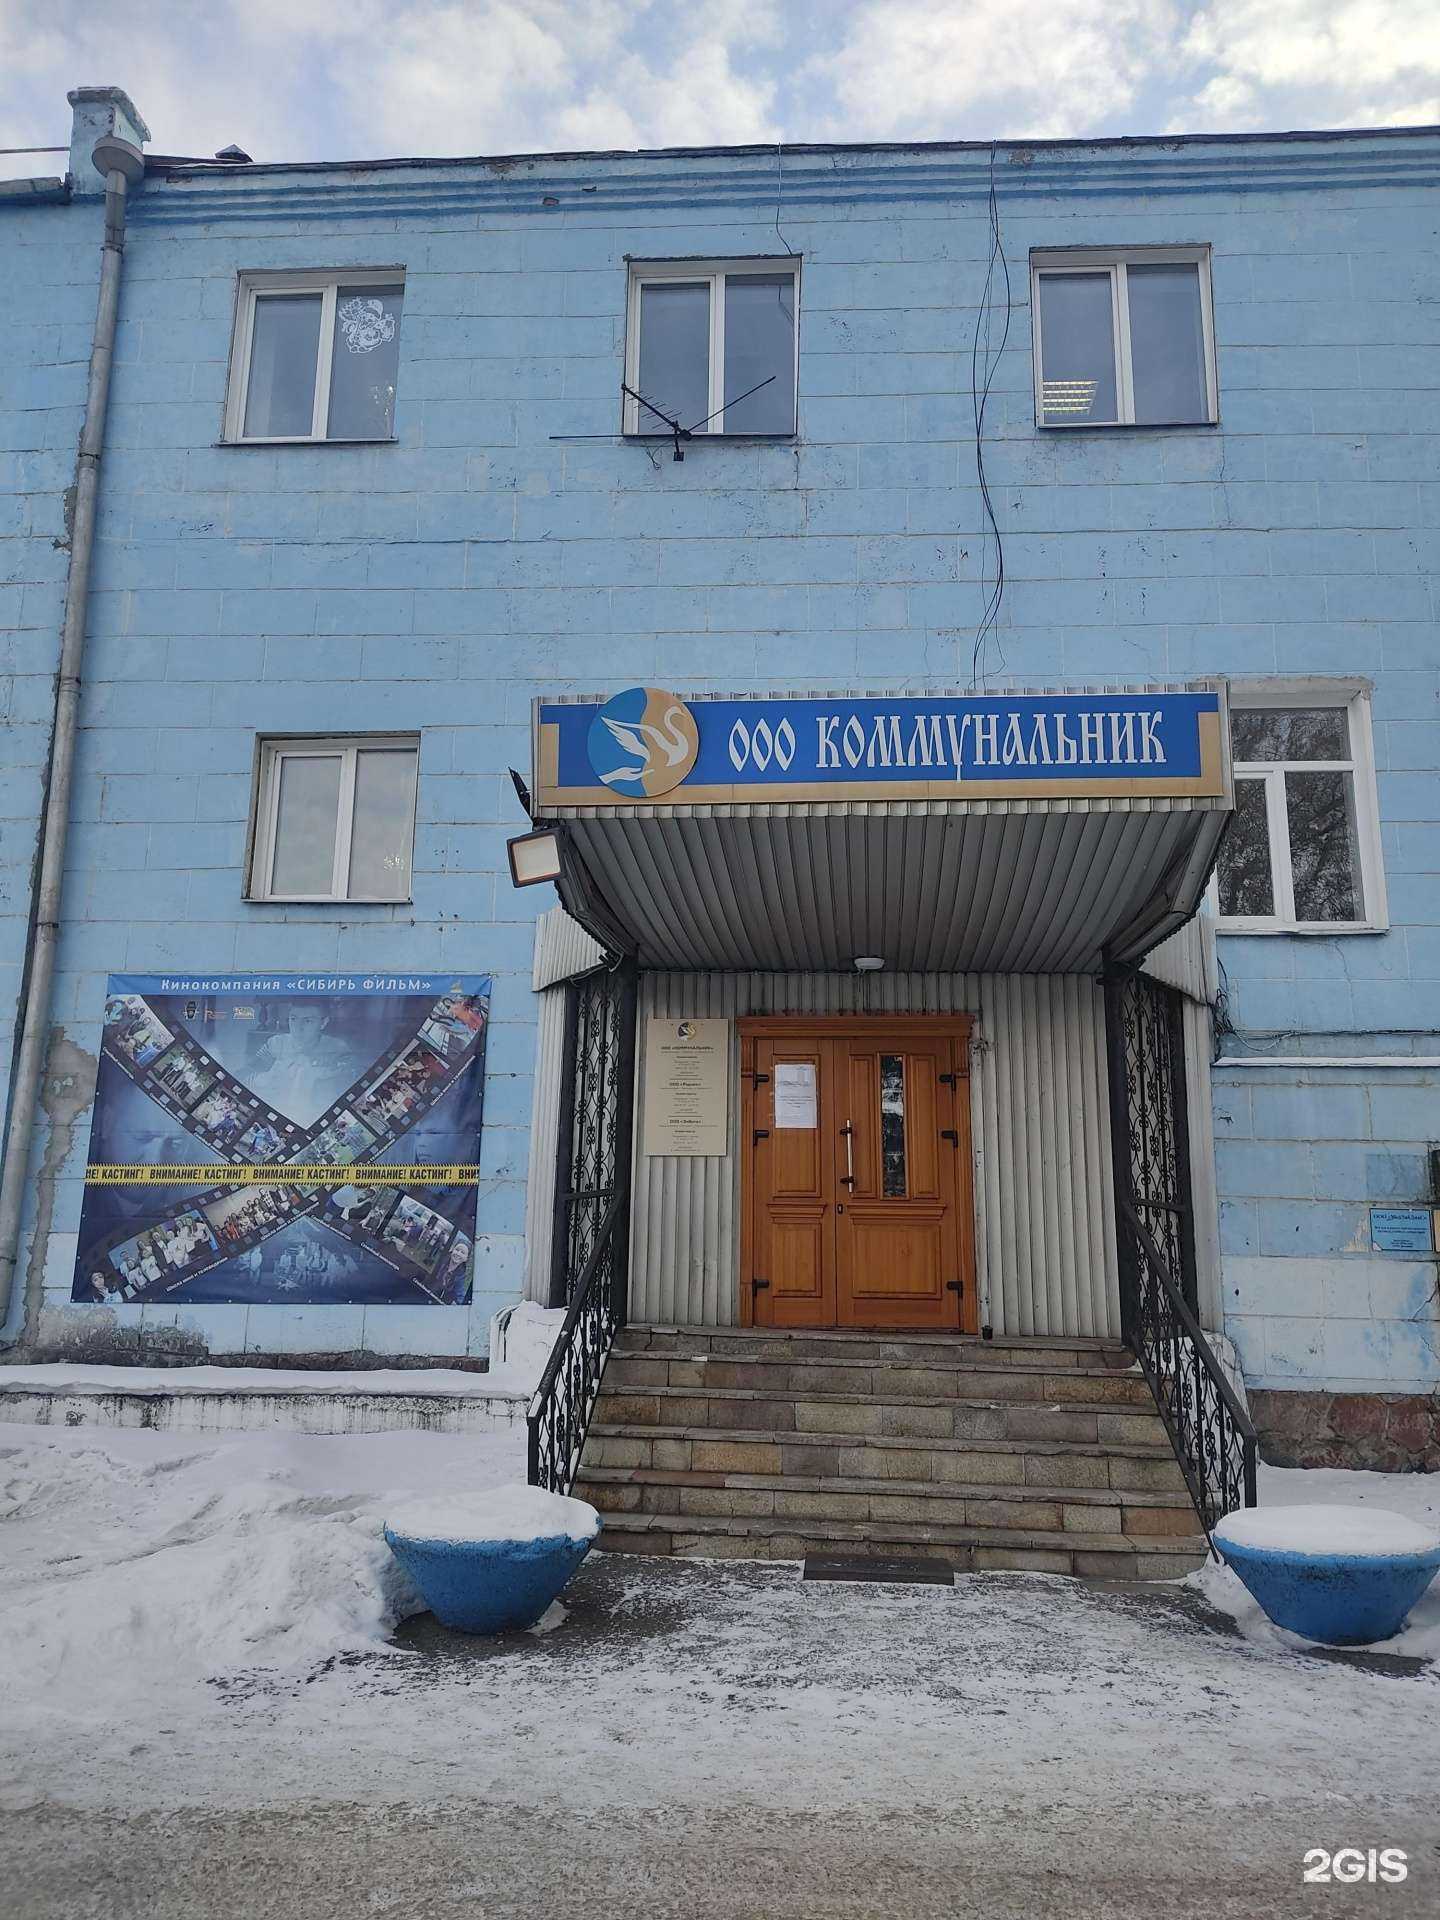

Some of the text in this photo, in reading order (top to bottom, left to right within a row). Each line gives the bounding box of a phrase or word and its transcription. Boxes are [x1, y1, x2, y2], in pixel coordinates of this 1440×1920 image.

[728, 710, 1168, 782] ООО КОММУНАЛЬНИК
[161, 978, 432, 991] Кинокомпания «СИБИРЬ ФИЛЬМ»
[102, 1168, 144, 1180] КАСТИНГ!
[150, 1168, 201, 1180] ВНИМАНИЕ!
[204, 1168, 247, 1180] КАСТИНГ!
[253, 1168, 304, 1180] ВНИМАНИЕ!
[307, 1168, 350, 1180] КАСТИНГ!
[355, 1168, 407, 1180] ВНИМАНИЕ!
[409, 1168, 452, 1180] КАСТИНГ!
